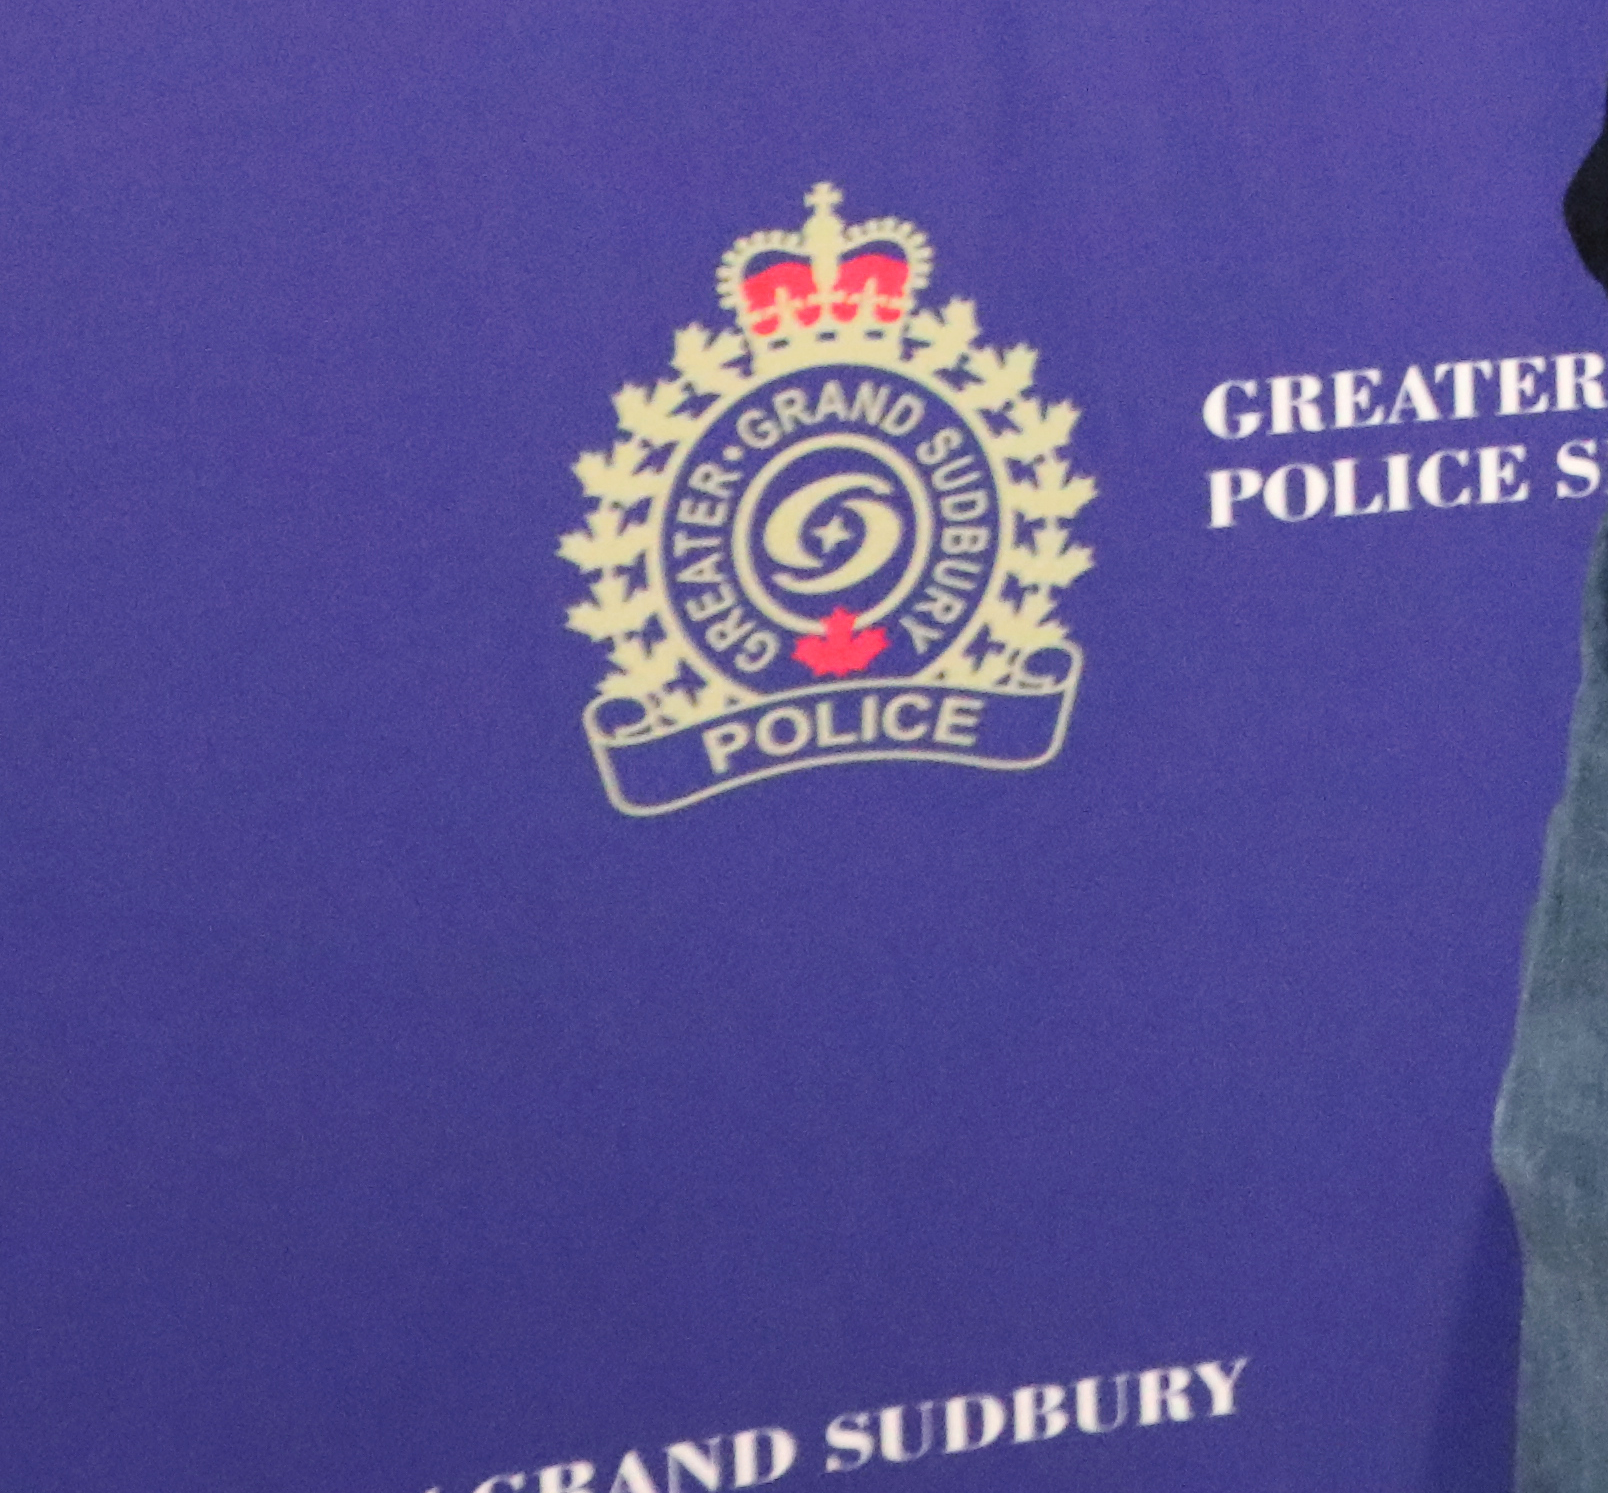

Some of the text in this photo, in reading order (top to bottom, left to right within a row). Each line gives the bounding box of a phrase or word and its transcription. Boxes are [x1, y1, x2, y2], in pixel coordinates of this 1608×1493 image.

[1203, 353, 1608, 439] GREATER
[673, 380, 991, 672] GREATER GRAND SUDBURY
[1209, 445, 1528, 528] POLICE
[702, 693, 984, 774] POLICE
[826, 1359, 1246, 1472] SUDBURY
